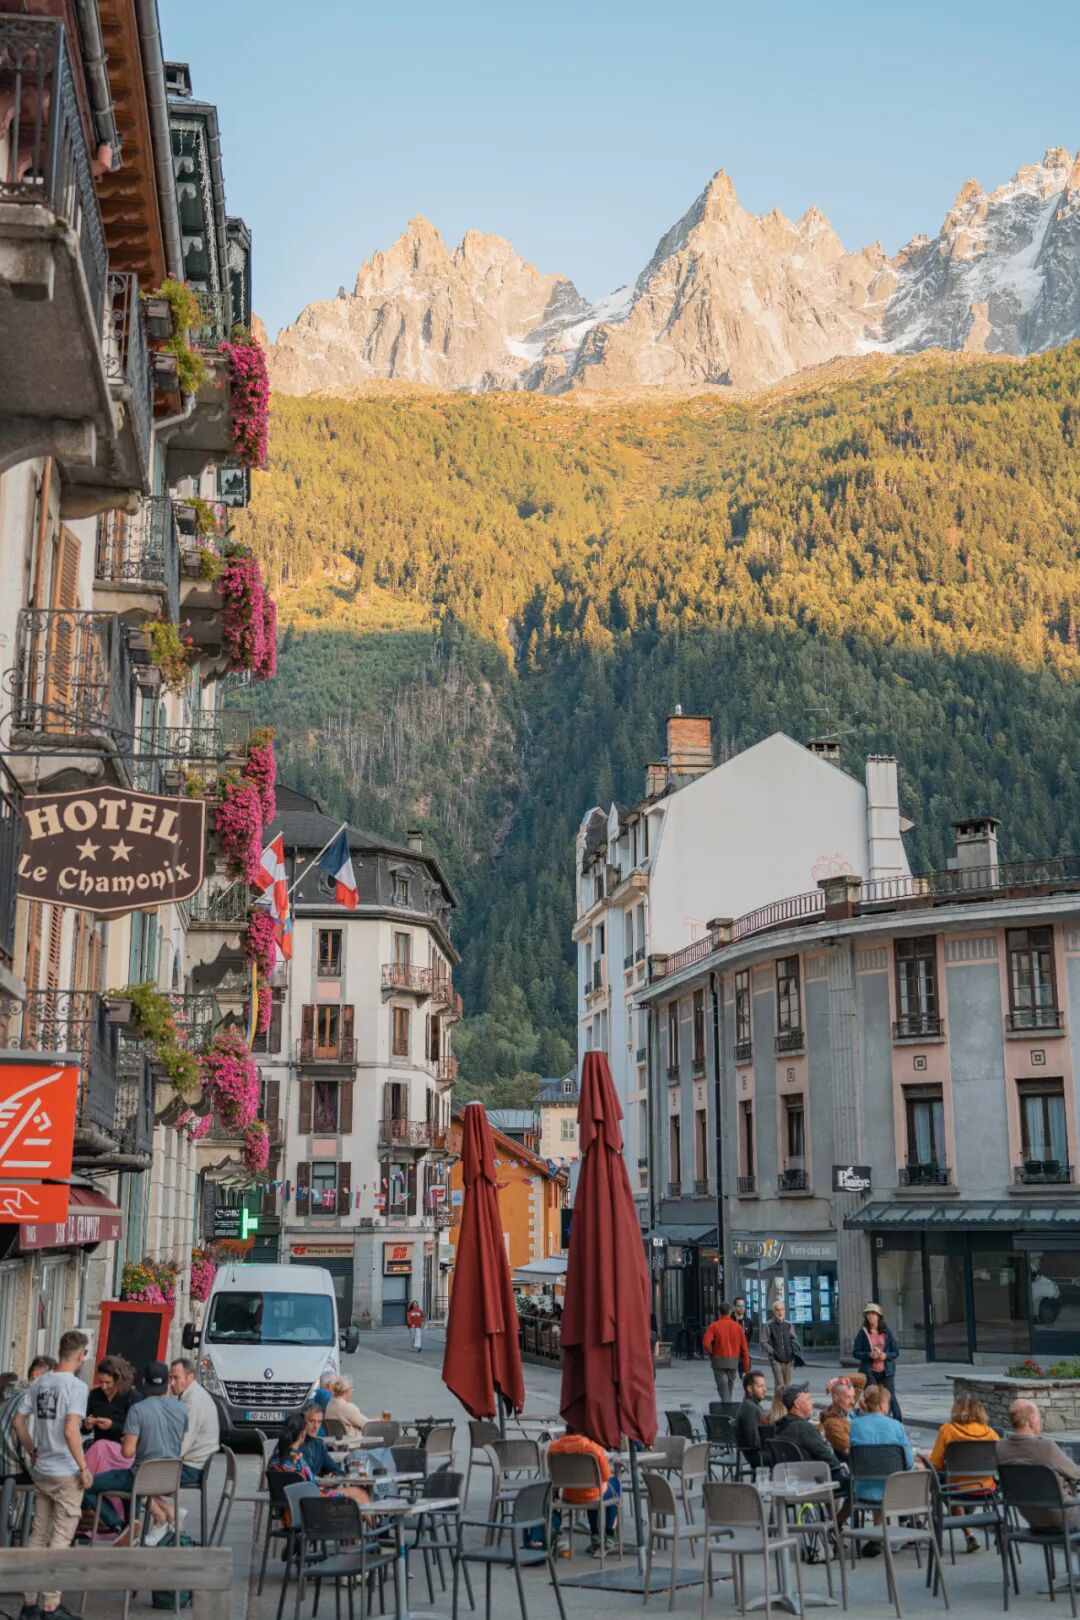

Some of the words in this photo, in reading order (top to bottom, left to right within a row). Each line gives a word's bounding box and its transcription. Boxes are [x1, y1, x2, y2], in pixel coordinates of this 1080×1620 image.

[24, 798, 180, 843] HOTEL
[18, 854, 48, 882] Le
[58, 860, 191, 896] Chamonix
